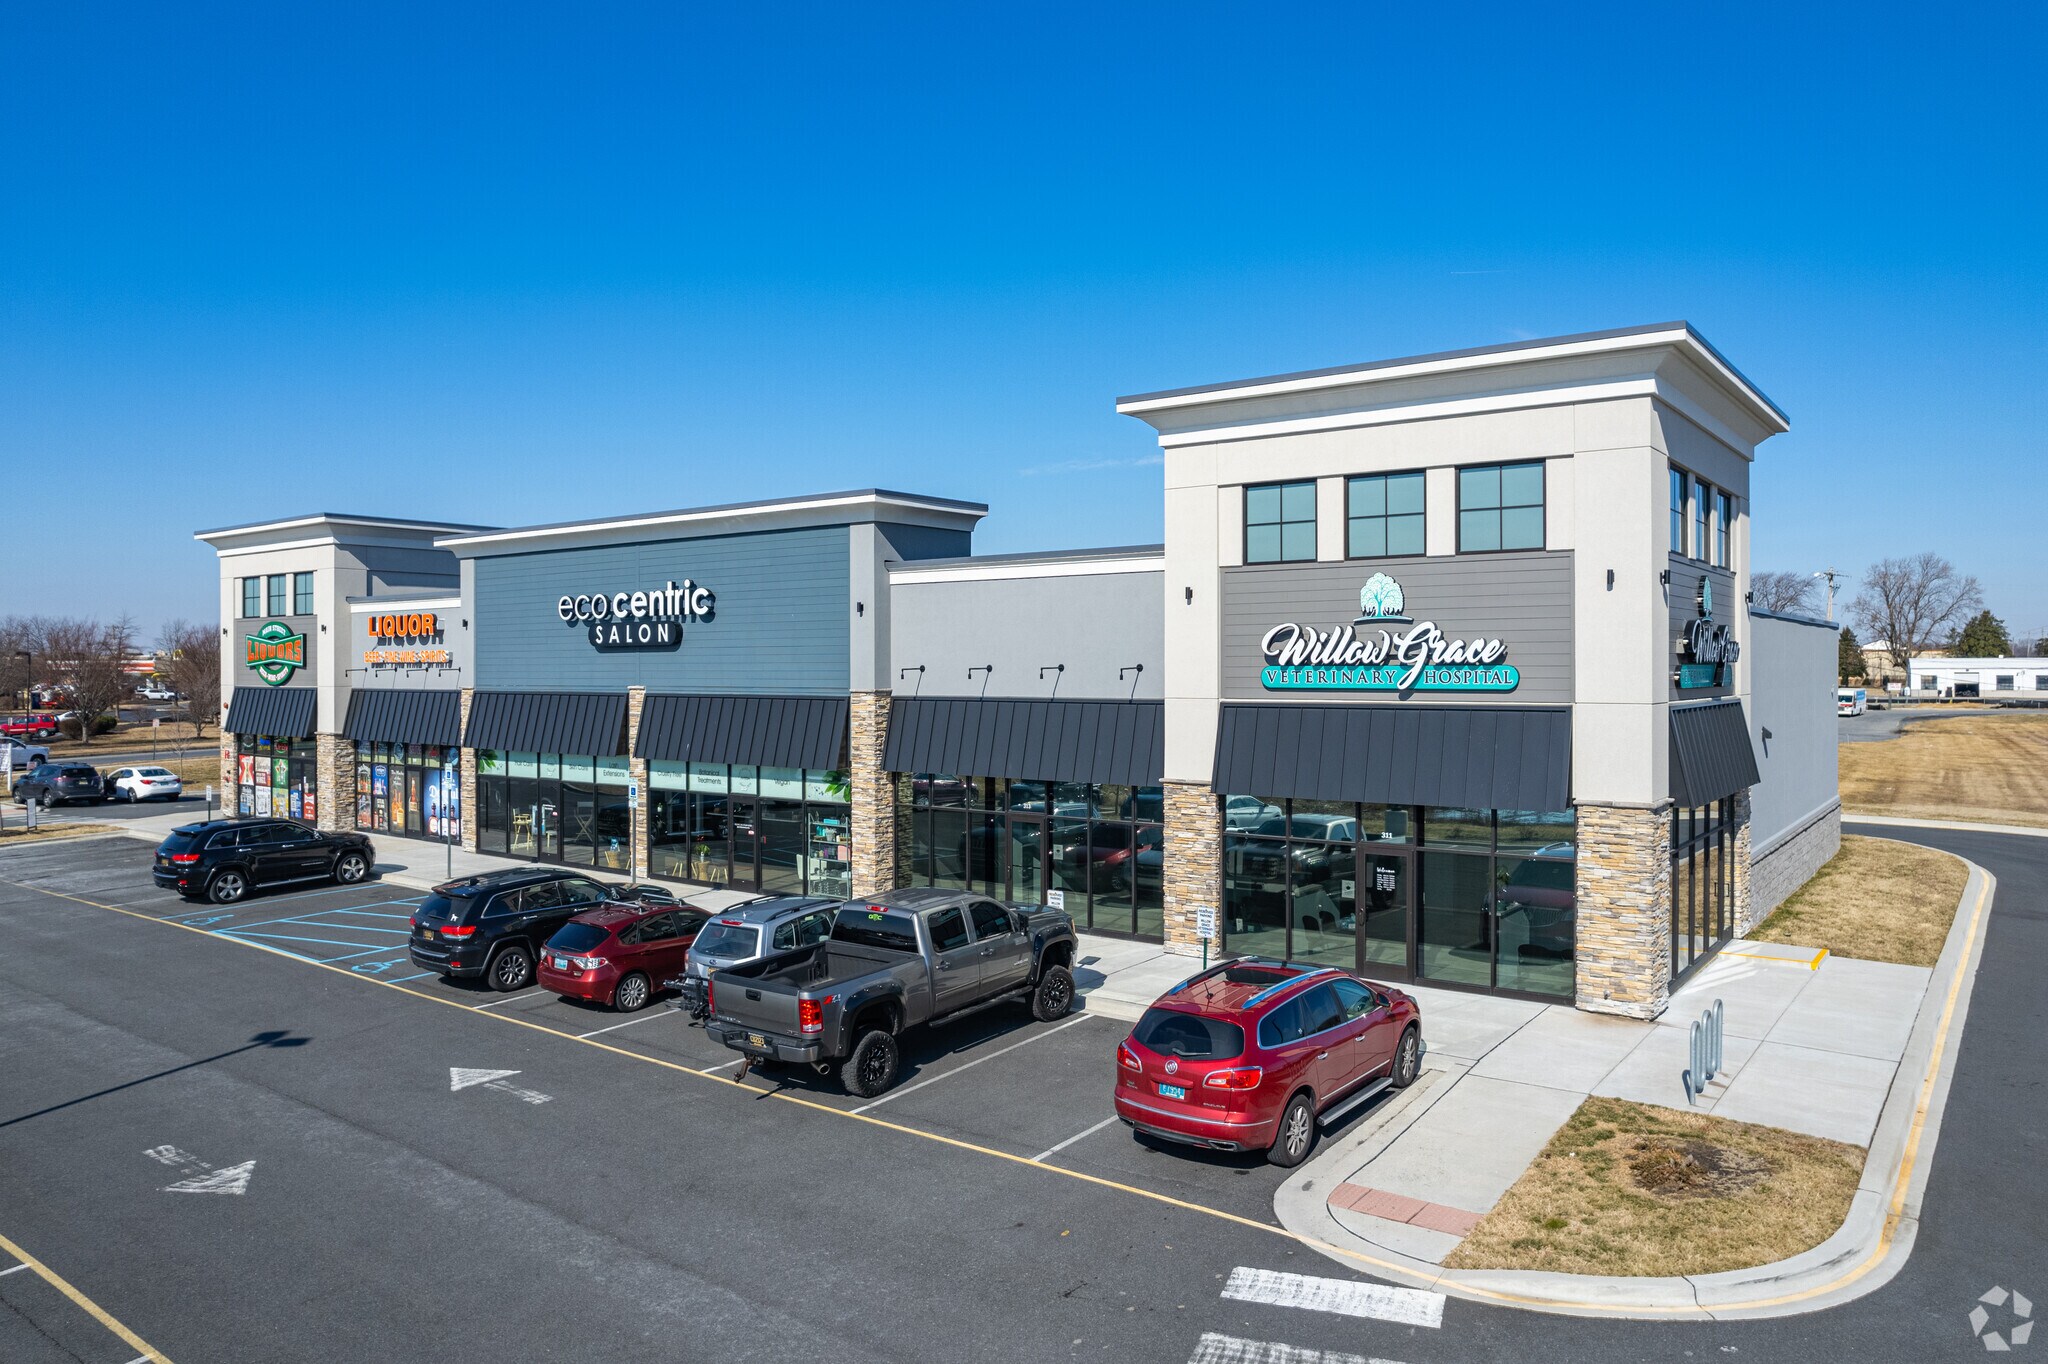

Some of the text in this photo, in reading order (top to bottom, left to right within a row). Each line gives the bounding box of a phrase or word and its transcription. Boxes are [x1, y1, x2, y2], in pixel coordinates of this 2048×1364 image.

[558, 579, 709, 620] eco centric
[368, 613, 434, 637] LIQUOR
[595, 623, 668, 644] SALON
[247, 640, 302, 662] LIQUORS
[1261, 621, 1505, 690] Willow Grace
[1266, 670, 1514, 685] VETERINARY HOSPITAL
[603, 770, 626, 778] Extensions
[697, 777, 721, 785] Treatments
[699, 768, 720, 776] Botanical
[774, 779, 791, 787] Vegan
